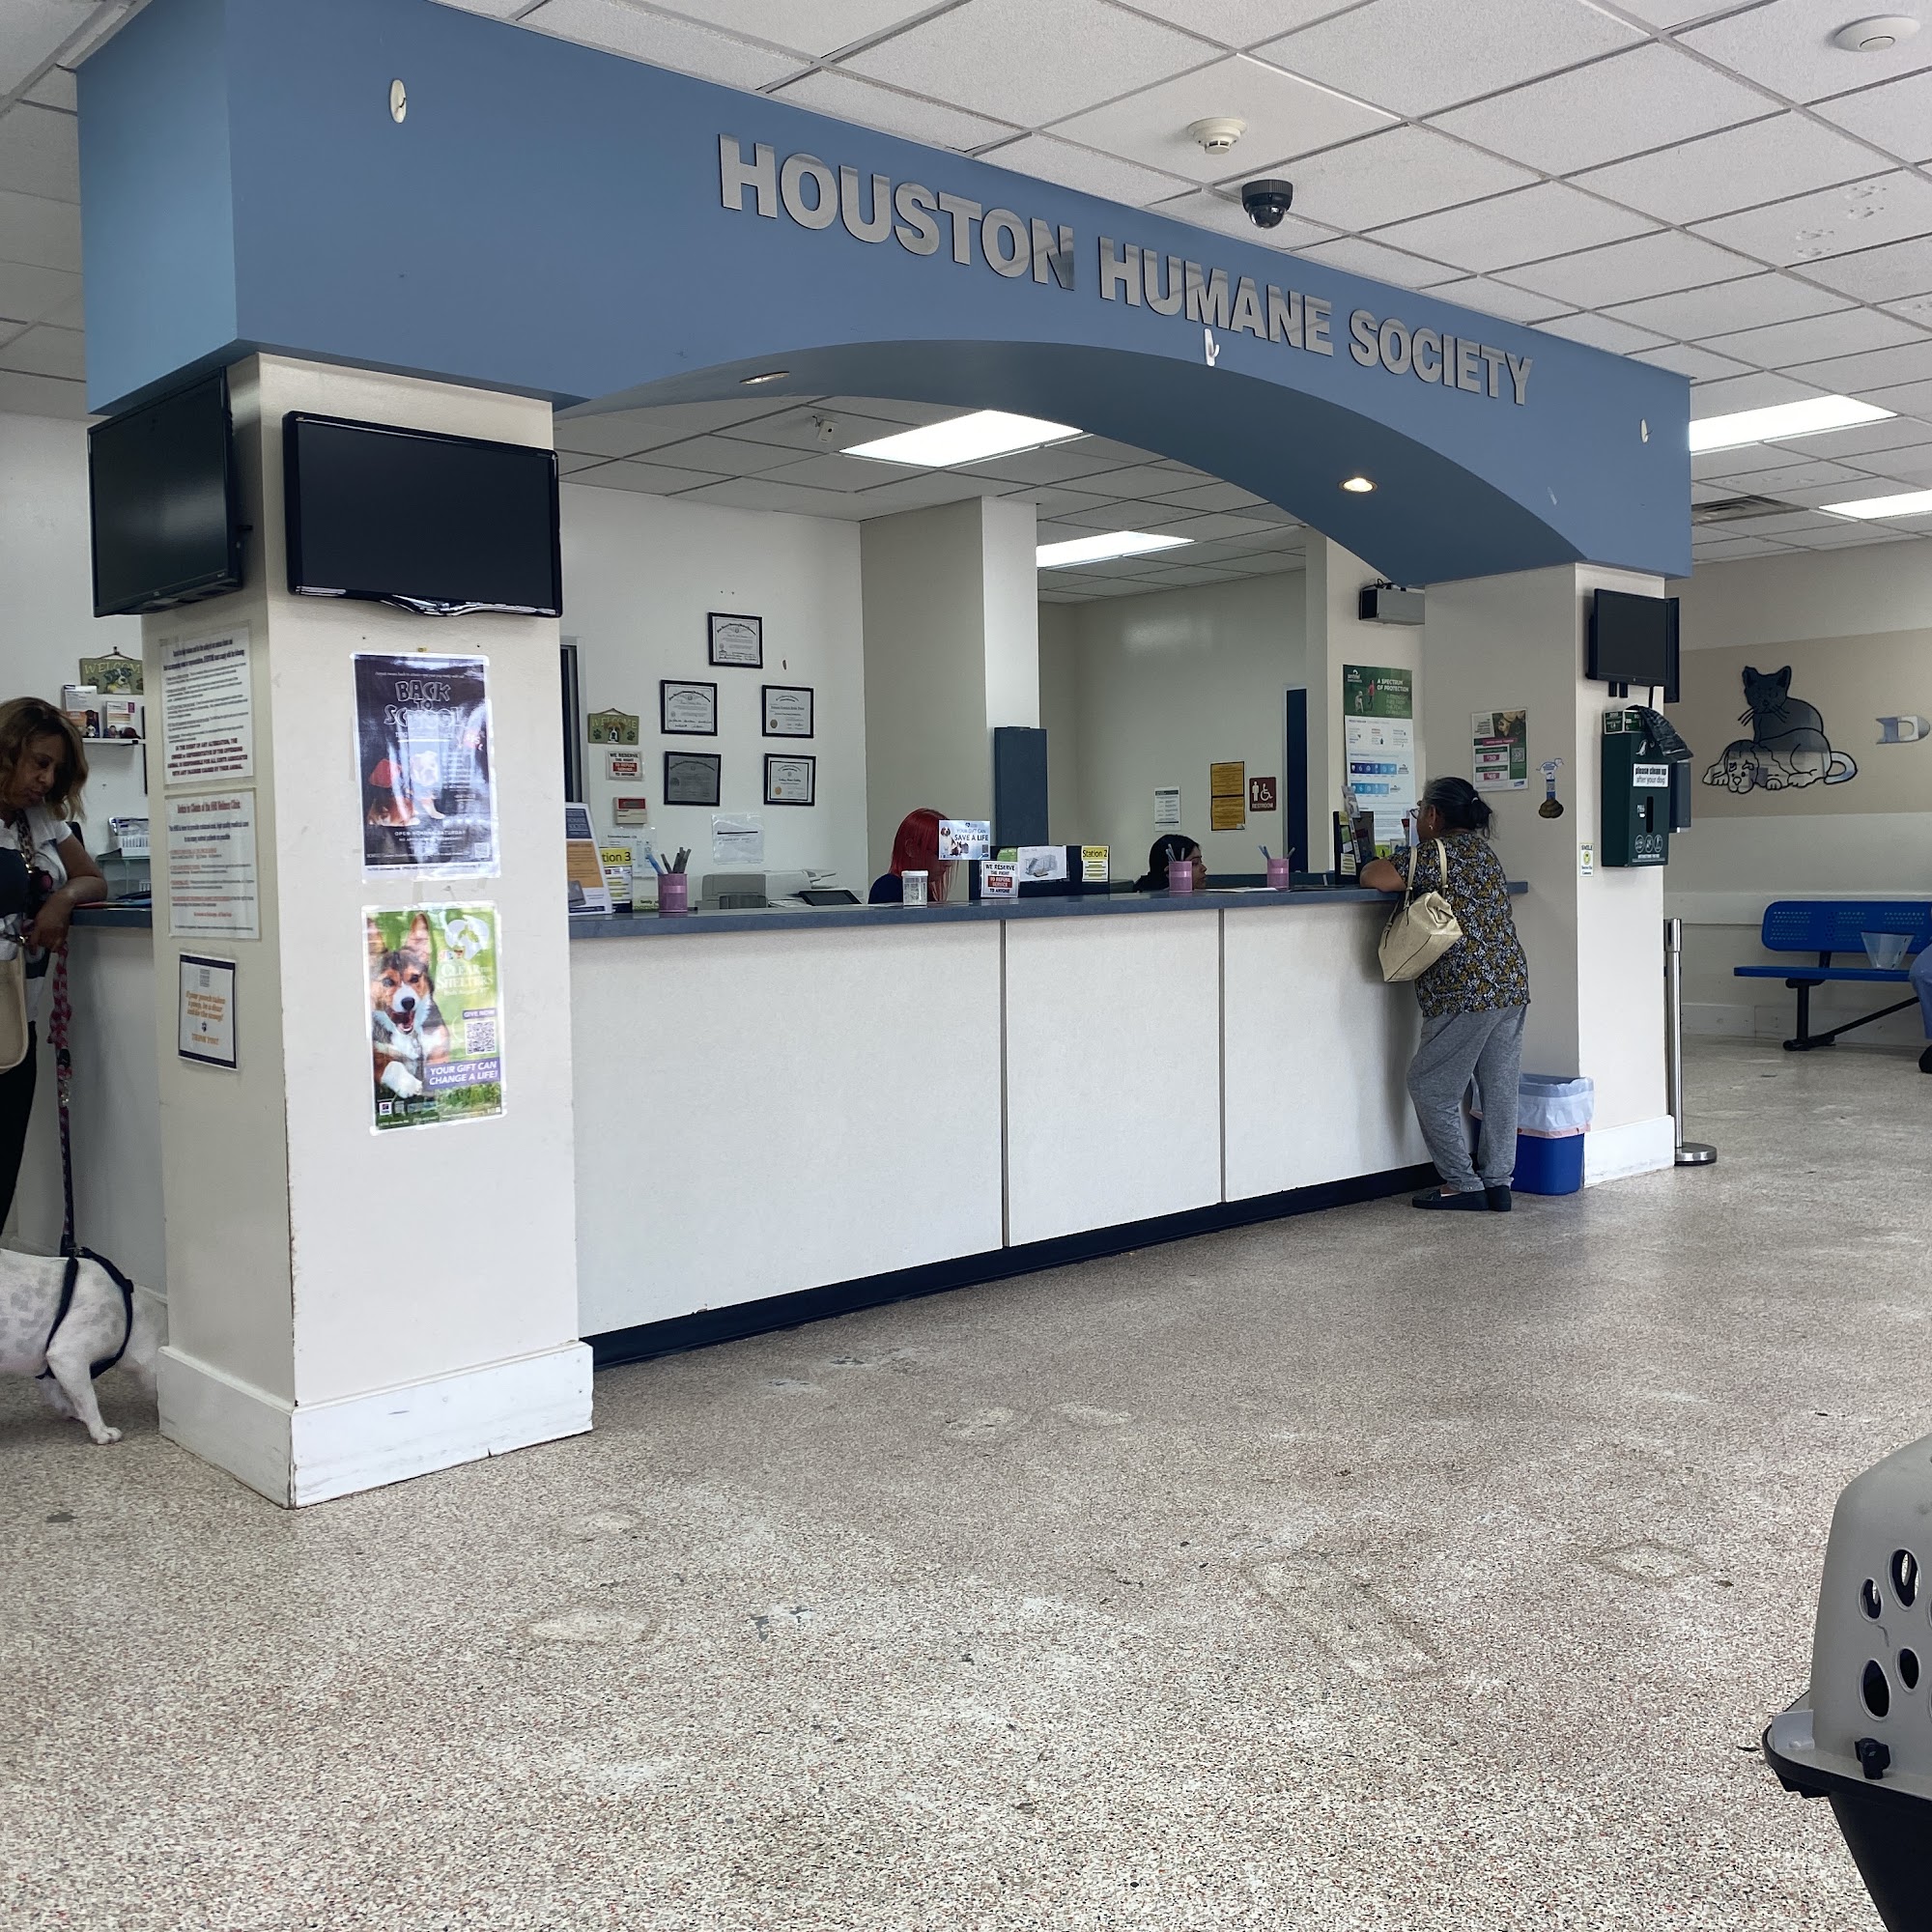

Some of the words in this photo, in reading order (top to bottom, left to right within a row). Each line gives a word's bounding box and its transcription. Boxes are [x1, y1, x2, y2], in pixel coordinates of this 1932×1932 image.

[718, 133, 1075, 291] HOUSTON
[1098, 236, 1334, 357] HUMANE
[1349, 308, 1534, 406] SOCIETY
[84, 662, 141, 674] WELCOM
[394, 679, 452, 702] BACK
[591, 718, 638, 729] WELCOME
[1635, 766, 1649, 775] please
[1657, 776, 1665, 785] dog
[601, 852, 623, 863] tion
[624, 851, 632, 862] 3
[1082, 849, 1103, 858] Station
[430, 1065, 456, 1075] YOUR
[457, 1064, 475, 1072] GIFT
[477, 1061, 497, 1069] CAN
[429, 1073, 468, 1085] CHANGE
[477, 1070, 498, 1080] LIFE!
